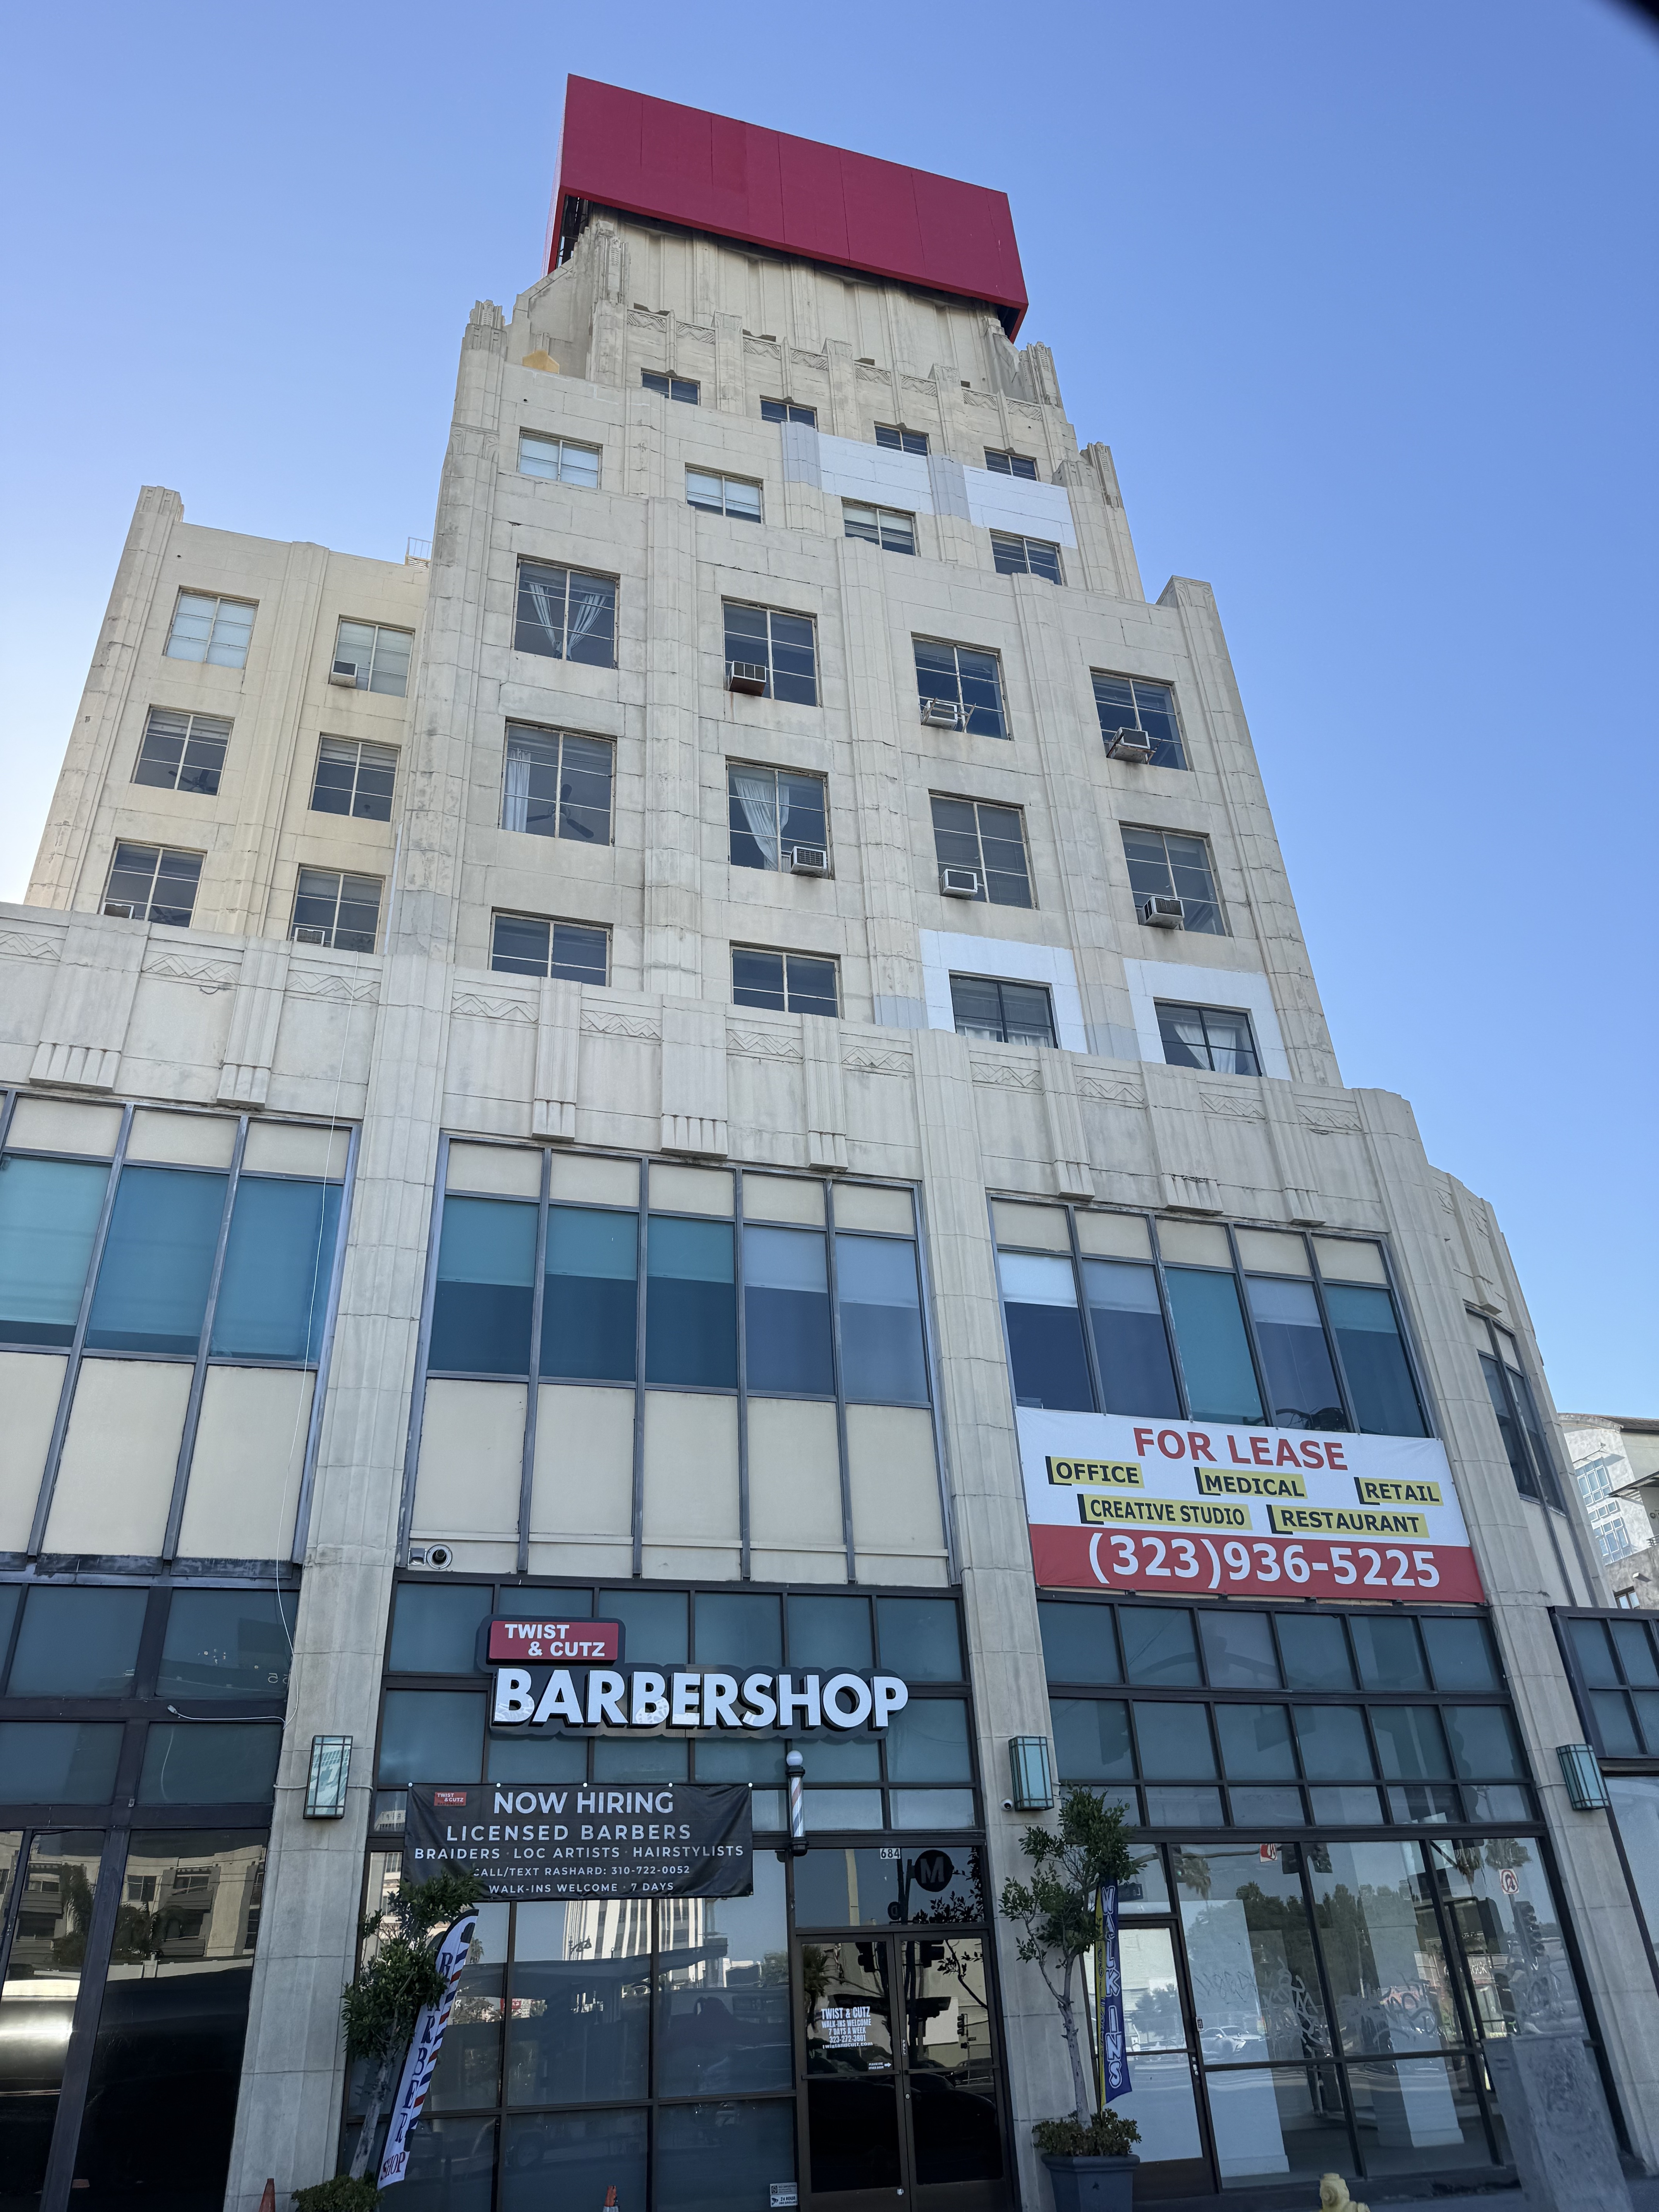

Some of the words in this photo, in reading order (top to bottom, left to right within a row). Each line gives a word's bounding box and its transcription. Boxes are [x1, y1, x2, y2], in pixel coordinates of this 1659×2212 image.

[1133, 1427, 1216, 1462] FOR
[1226, 1435, 1348, 1471] LEASE
[1055, 1462, 1139, 1484] OFFICE
[1205, 1474, 1305, 1497] MEDICAL
[1365, 1482, 1439, 1502] RETAIL
[1090, 1499, 1175, 1523] CREATIVE
[1180, 1505, 1245, 1526] STUDIO
[1281, 1509, 1419, 1533] RESTAURANT
[1088, 1532, 1440, 1590] (323)936-5225
[505, 1624, 570, 1640] TWIST
[528, 1642, 543, 1656] &
[550, 1642, 605, 1657] CUTZ
[493, 1668, 908, 1729] BARBERSHOP
[494, 1792, 568, 1814] NOW
[577, 1792, 673, 1814] HIRING
[447, 1825, 569, 1841] LICENSED
[581, 1824, 691, 1840] BARBERS
[414, 1848, 500, 1859] BRAIDERS
[514, 1847, 545, 1858] LOC
[553, 1847, 620, 1858] ARTISTS
[634, 1845, 744, 1857] HAIRSTYLISTS
[881, 1848, 900, 1858] 684
[473, 1867, 540, 1877] CALL/TEXT
[545, 1867, 607, 1875] RASHARD:
[611, 1865, 690, 1875] 310-722-0052
[489, 1883, 551, 1893] WALK-INS
[557, 1883, 618, 1892] WELCOME
[631, 1883, 637, 1891] 7
[643, 1882, 674, 1891] DAYS
[1102, 1886, 1120, 1997] WALK
[821, 2008, 843, 2020] TWIST
[846, 2008, 851, 2018] &
[853, 2006, 871, 2018] CUTZ
[822, 2020, 845, 2028] WALK-INS
[847, 2018, 871, 2027] WELCOME
[395, 1952, 453, 2143] BRBER
[1106, 2005, 1122, 2089] INS
[381, 2151, 405, 2181] SHOP
